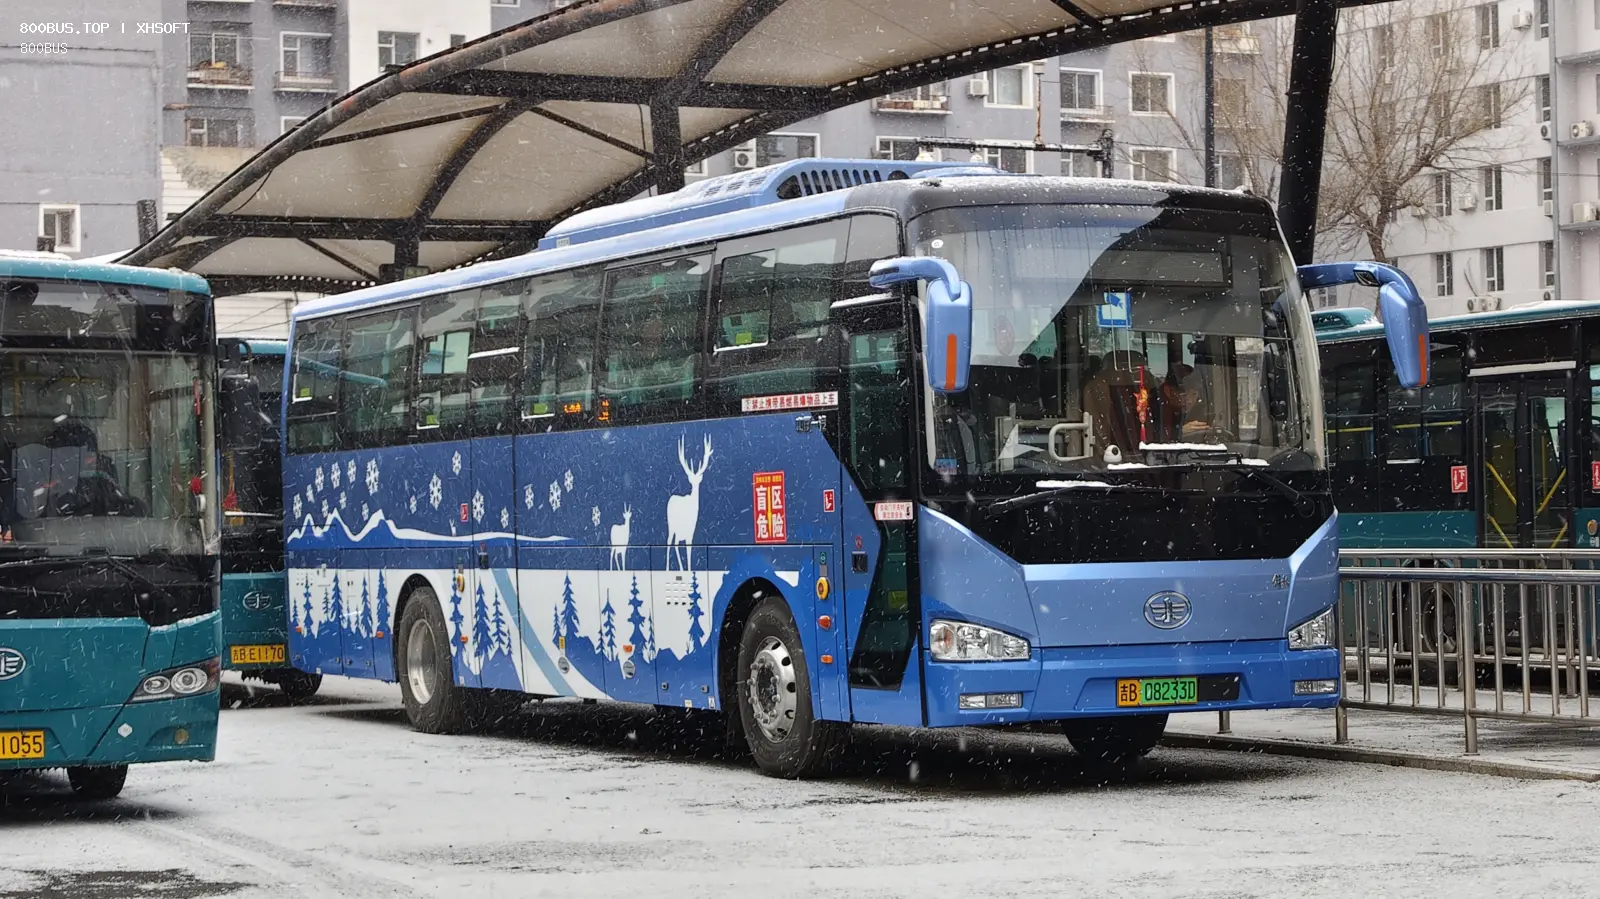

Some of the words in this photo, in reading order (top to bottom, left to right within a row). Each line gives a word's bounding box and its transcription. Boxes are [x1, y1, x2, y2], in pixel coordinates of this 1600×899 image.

[756, 485, 783, 510] 盲区
[756, 513, 784, 538] 危险
[1120, 683, 1138, 702] 吉B
